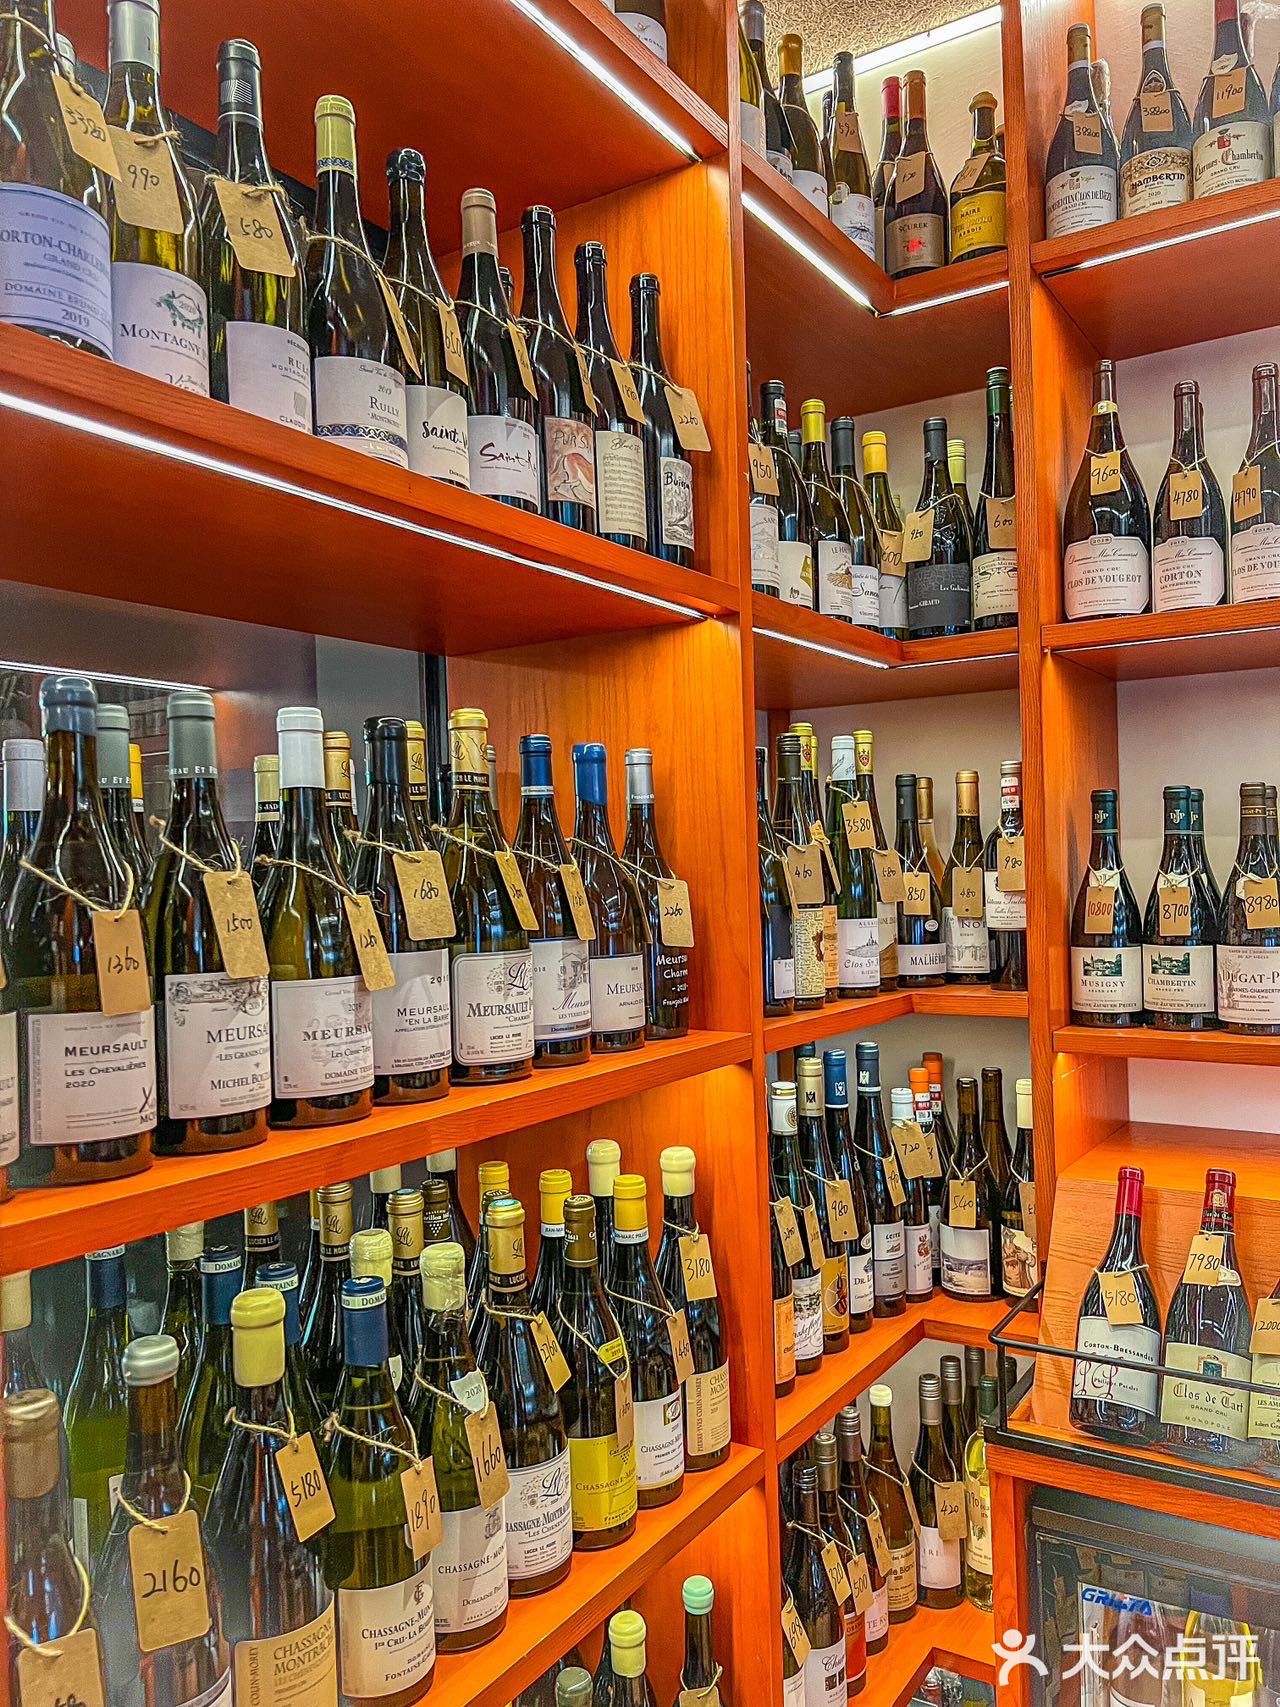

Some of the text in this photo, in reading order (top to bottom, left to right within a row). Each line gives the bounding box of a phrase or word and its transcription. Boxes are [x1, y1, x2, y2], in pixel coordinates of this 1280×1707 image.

[1215, 85, 1244, 101] 11900
[127, 164, 161, 191] 990
[5, 282, 64, 300] DOMAINE
[61, 309, 90, 328] 2019
[119, 322, 202, 357] MONTAGNY
[368, 394, 401, 420] RULLY
[752, 459, 772, 480] 950
[1091, 464, 1119, 485] 9600
[1173, 489, 1199, 504] 4780
[1233, 489, 1257, 507] 4790
[994, 512, 1013, 529] 600
[1244, 555, 1266, 563] GRAND
[1082, 567, 1104, 575] GRAND
[1158, 569, 1202, 583] CORTON
[1161, 564, 1180, 573] GRAND
[1247, 564, 1259, 574] DE
[1085, 577, 1098, 586] DE
[1097, 574, 1142, 586] VOUGEOT
[844, 817, 871, 836] 3580
[1004, 855, 1023, 870] 980
[413, 878, 440, 901] 1680
[906, 885, 925, 902] 850
[1087, 903, 1113, 918] 10800
[1246, 894, 1278, 914] 8980
[1162, 903, 1189, 923] 8700
[226, 912, 253, 933] 1500
[533, 966, 547, 974] 018
[843, 958, 863, 969] Clos
[1081, 978, 1126, 988] MUSIGNY
[1147, 978, 1197, 987] CHAMBERTIN
[1222, 969, 1280, 984] DUGAT-P
[466, 1001, 528, 1018] MEURSAULT
[422, 1016, 432, 1025] LA
[64, 1038, 148, 1057] MEURSAULT
[331, 1048, 344, 1059] Les
[64, 1061, 147, 1078] LES CHEVALIÈRES
[324, 1068, 358, 1080] DOMAINE
[65, 1079, 96, 1089] 2020
[210, 1076, 251, 1091] MICHEL
[901, 1143, 920, 1156] 720
[832, 1199, 849, 1217] 980
[951, 1200, 974, 1211] 540
[684, 1258, 711, 1281] 3180
[1189, 1253, 1221, 1272] 7980
[1105, 1290, 1136, 1308] 5180
[1083, 1340, 1155, 1363] CORTON-BRESSANDES
[465, 1383, 483, 1399] 2020
[1172, 1381, 1245, 1415] Clos de Tart
[1190, 1403, 1229, 1418] GRAND CRU
[1185, 1414, 1232, 1432] MONOPOLE
[476, 1433, 502, 1483] 1660
[290, 1469, 322, 1508] 5180
[411, 1488, 436, 1534] 1890
[940, 1500, 959, 1514] 420
[142, 1559, 201, 1599] 2160
[853, 1574, 868, 1599] 500
